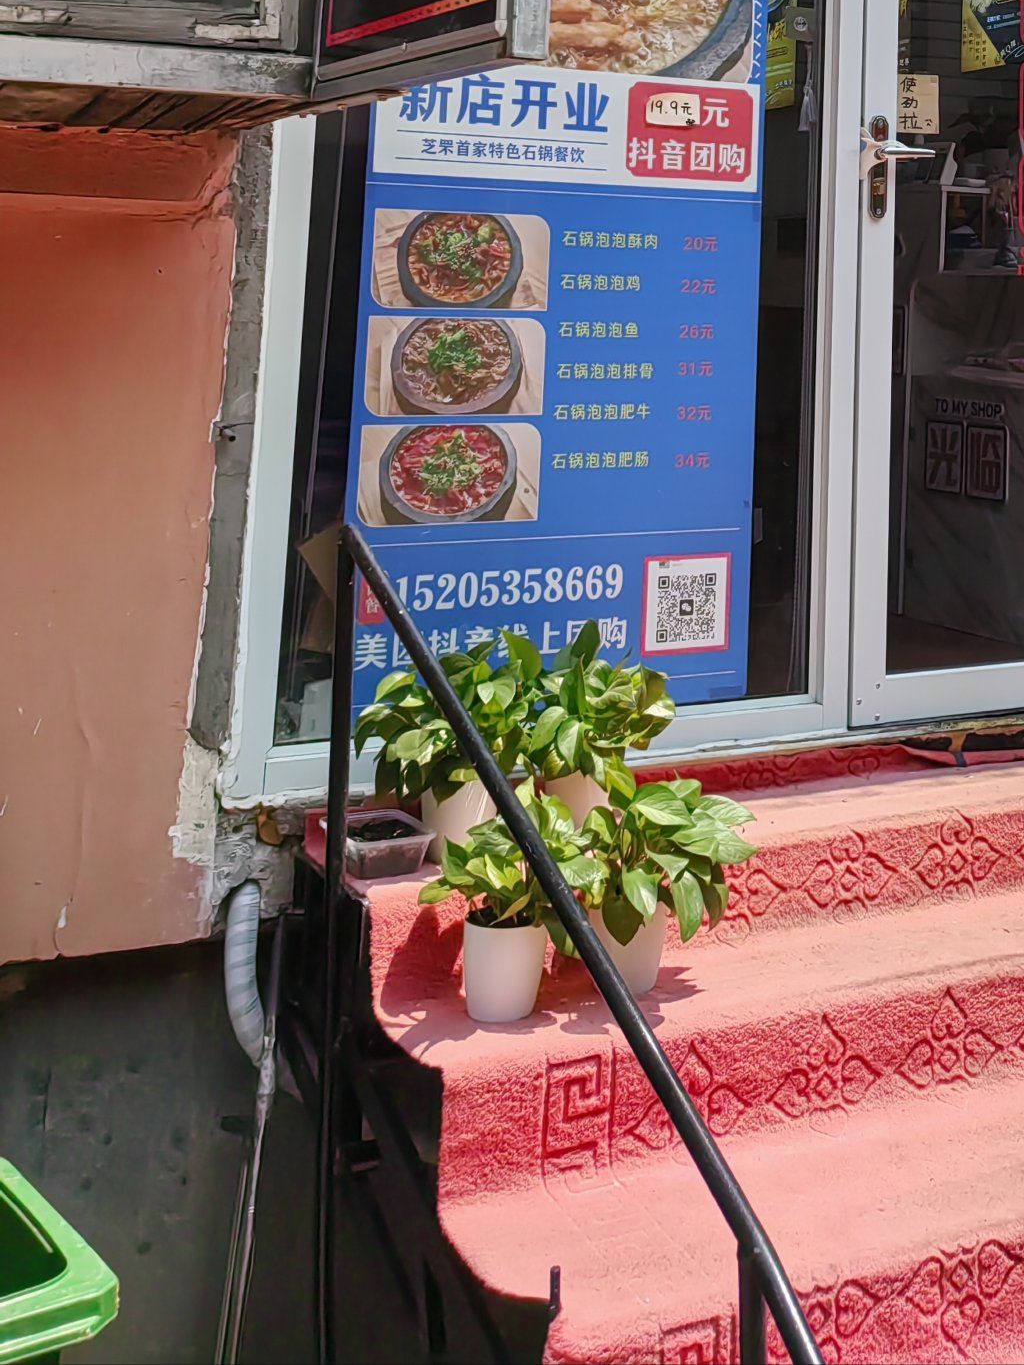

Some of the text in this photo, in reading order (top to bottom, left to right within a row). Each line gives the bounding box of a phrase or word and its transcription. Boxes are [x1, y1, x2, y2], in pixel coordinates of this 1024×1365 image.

[399, 74, 610, 133] 新店开业
[650, 100, 693, 116] 19.9元
[702, 97, 730, 128] 元
[420, 137, 586, 164] 芝罘首家特色石锅餐饮
[627, 136, 746, 175] 抖音团购
[562, 230, 719, 253] 石锅泡泡酥肉 20元
[560, 273, 717, 295] 石锅泡泡鸡 22元
[558, 321, 640, 339] 石锅泡泡鱼
[556, 361, 714, 380] 石锅泡泡排骨 31元
[553, 402, 712, 421] 石锅泡泡肥牛 32元
[934, 398, 1004, 419] TO MY SHOP
[551, 450, 711, 469] 石锅泡泡肥肠 34元
[395, 563, 625, 612] 15205358669
